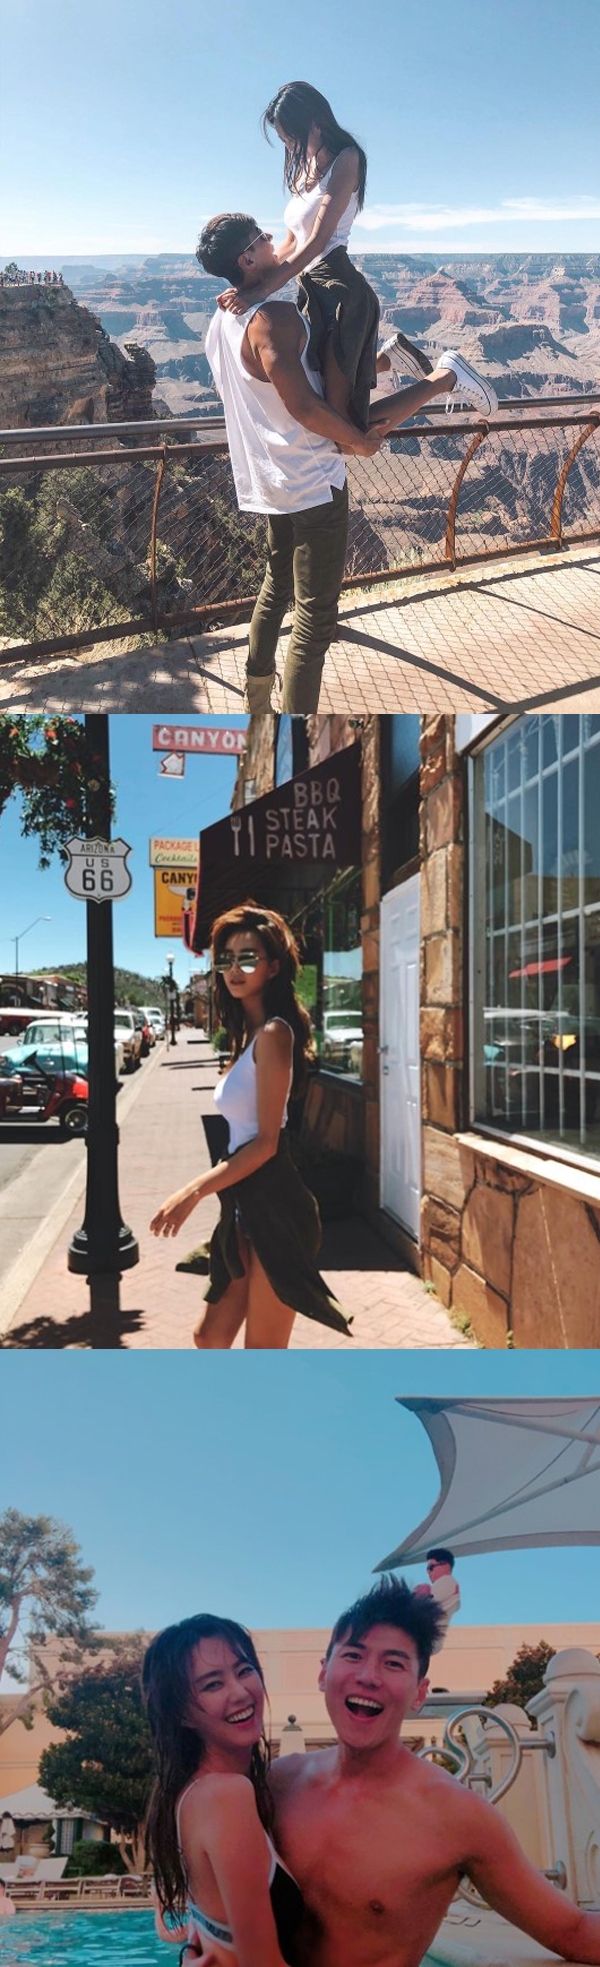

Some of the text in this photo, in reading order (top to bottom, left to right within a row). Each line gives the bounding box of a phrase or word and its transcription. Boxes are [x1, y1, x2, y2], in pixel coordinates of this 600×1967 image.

[294, 778, 341, 807] BBQ
[265, 806, 337, 831] STEAK
[80, 843, 116, 854] ARIZONA
[154, 840, 192, 852] PACKAGE
[266, 833, 336, 859] PASTA
[154, 852, 198, 864] Cocktails
[82, 869, 114, 892] 66
